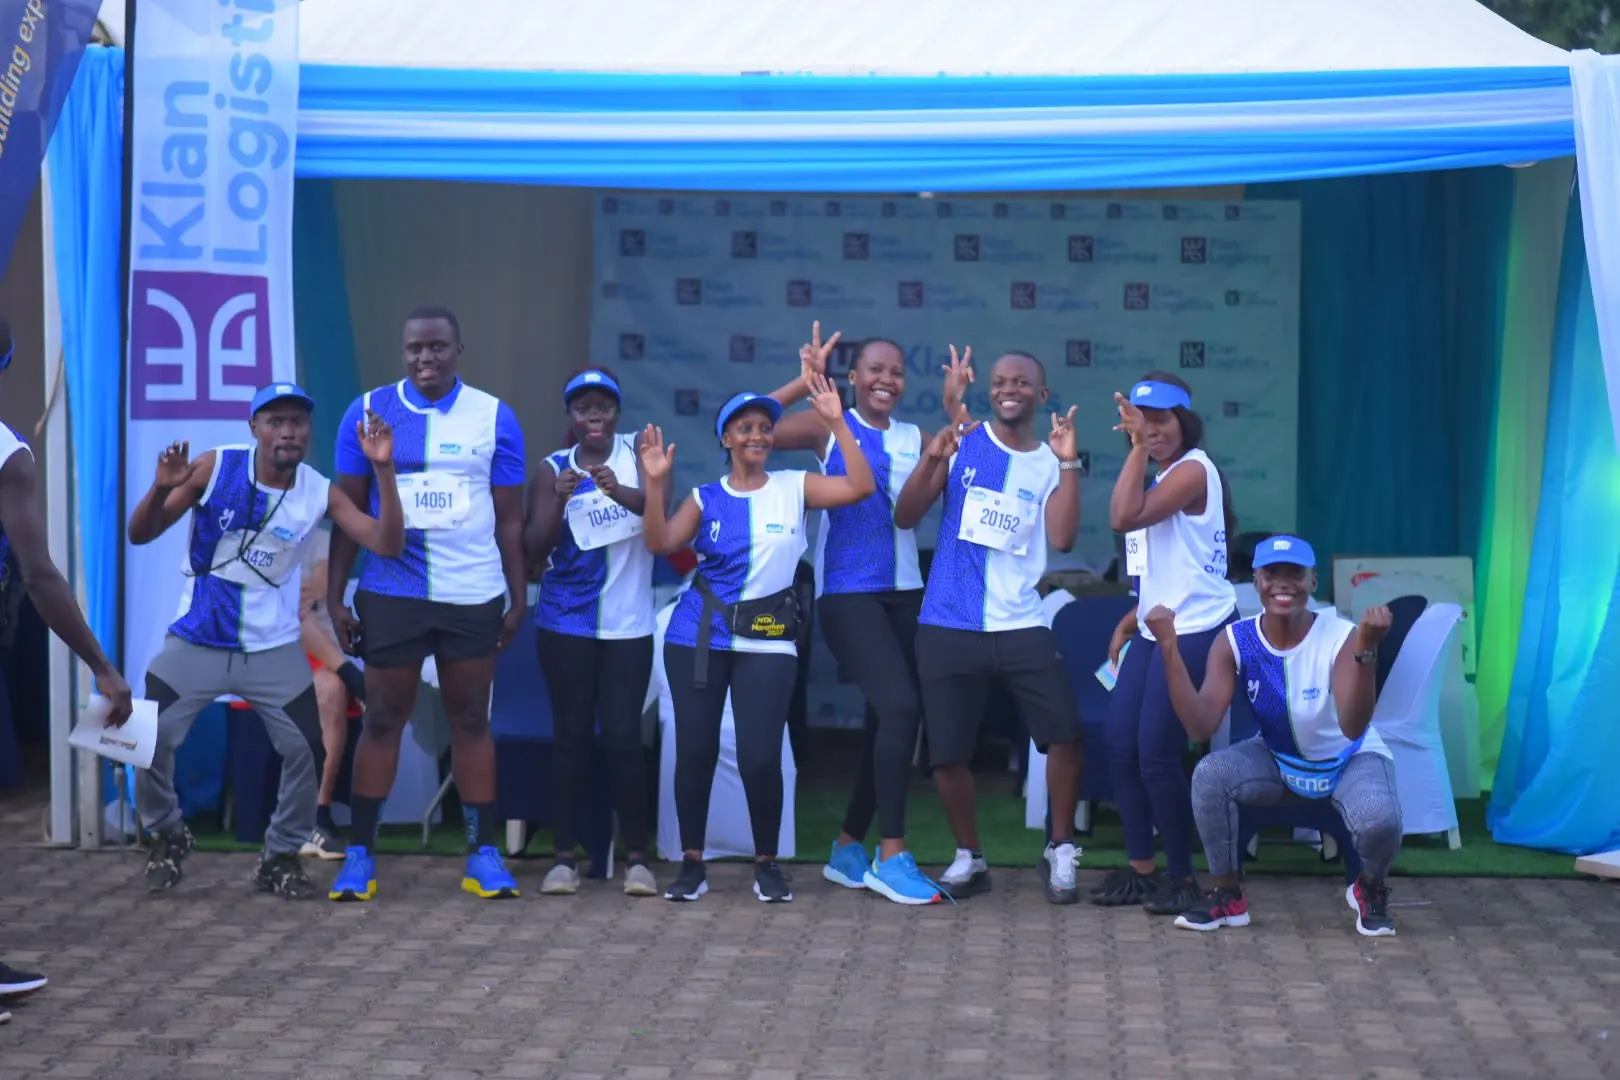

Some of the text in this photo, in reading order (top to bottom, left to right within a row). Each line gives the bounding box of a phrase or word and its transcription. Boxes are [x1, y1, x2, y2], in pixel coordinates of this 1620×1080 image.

[0, 44, 31, 159] uilding
[138, 80, 210, 260] Klan
[414, 491, 453, 509] 14051
[588, 504, 628, 527] 10433
[980, 508, 1020, 532] 20152
